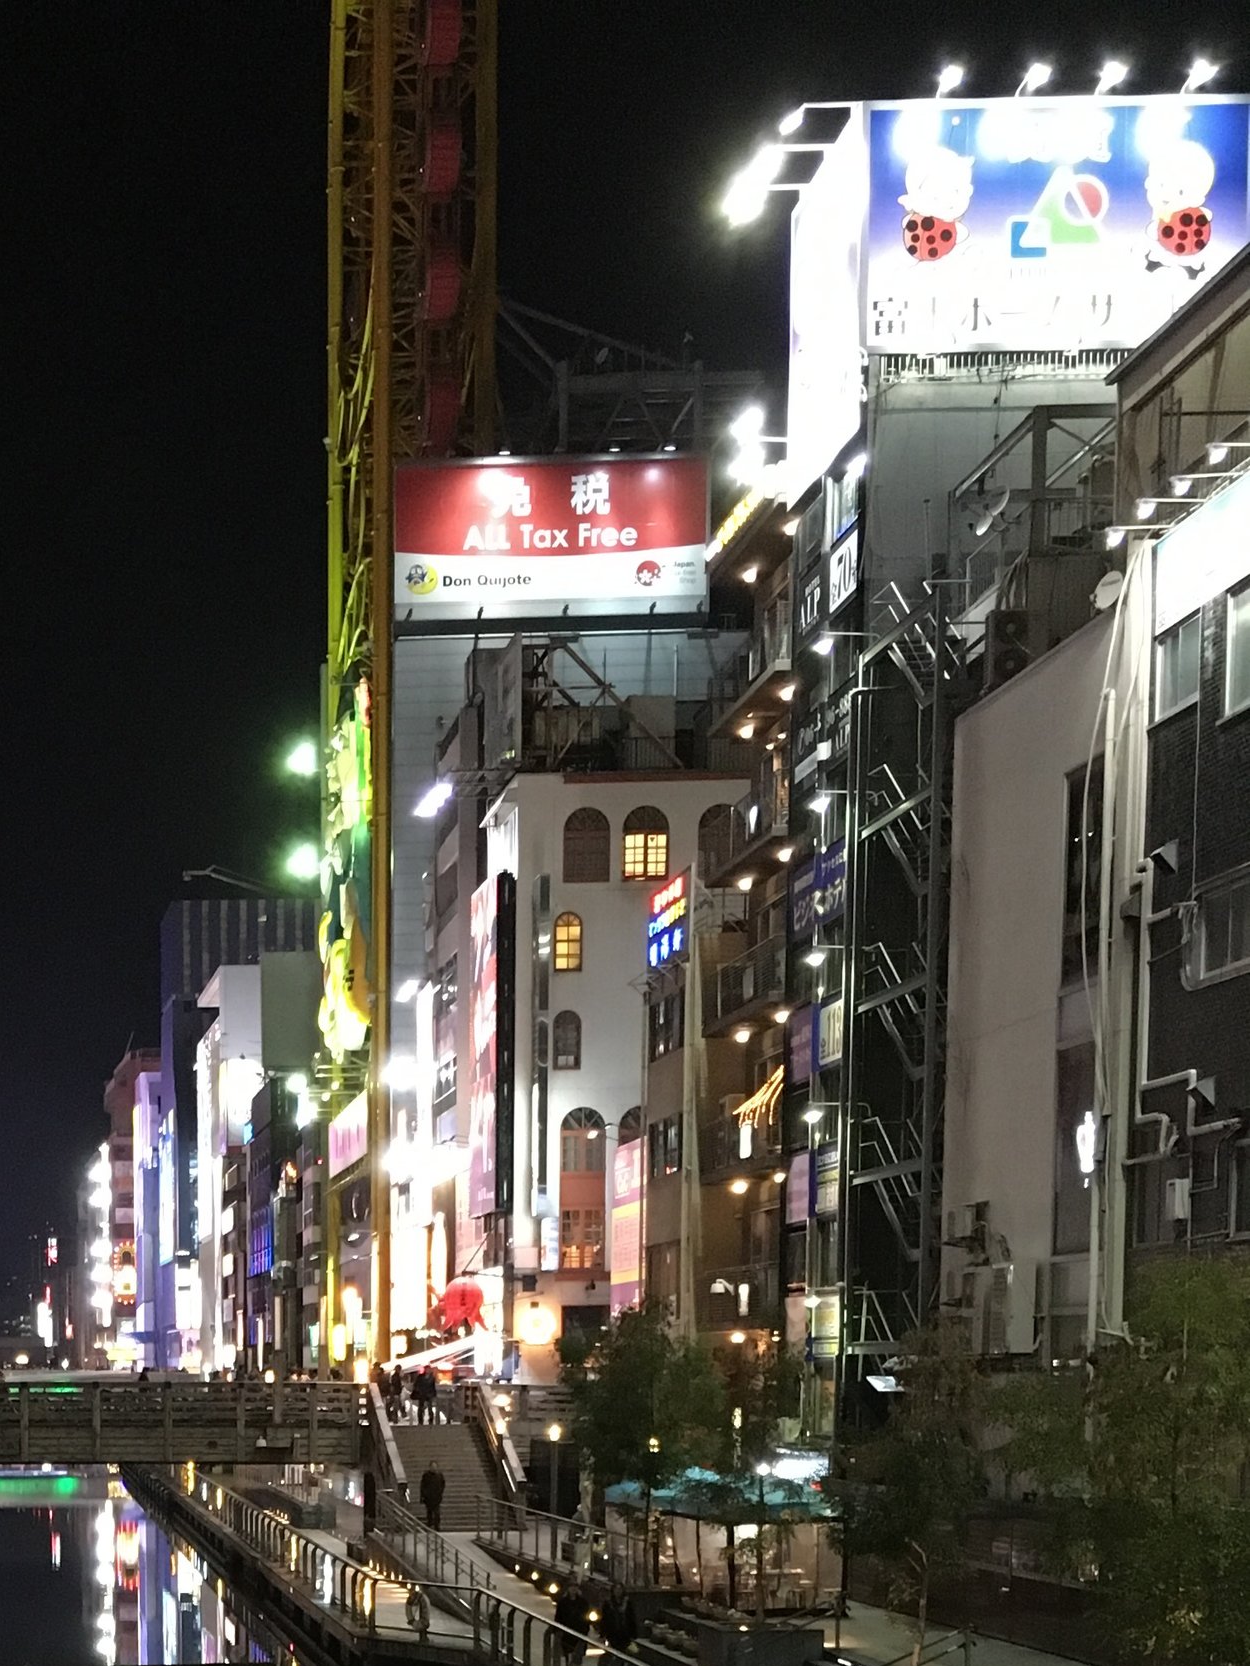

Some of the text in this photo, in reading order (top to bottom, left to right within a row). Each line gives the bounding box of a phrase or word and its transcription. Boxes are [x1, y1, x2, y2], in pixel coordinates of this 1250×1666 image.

[481, 471, 611, 518] 免税
[520, 525, 569, 550] Tax
[578, 522, 639, 549] Free
[442, 573, 532, 588] Don Quijote
[800, 586, 821, 629] ALP
